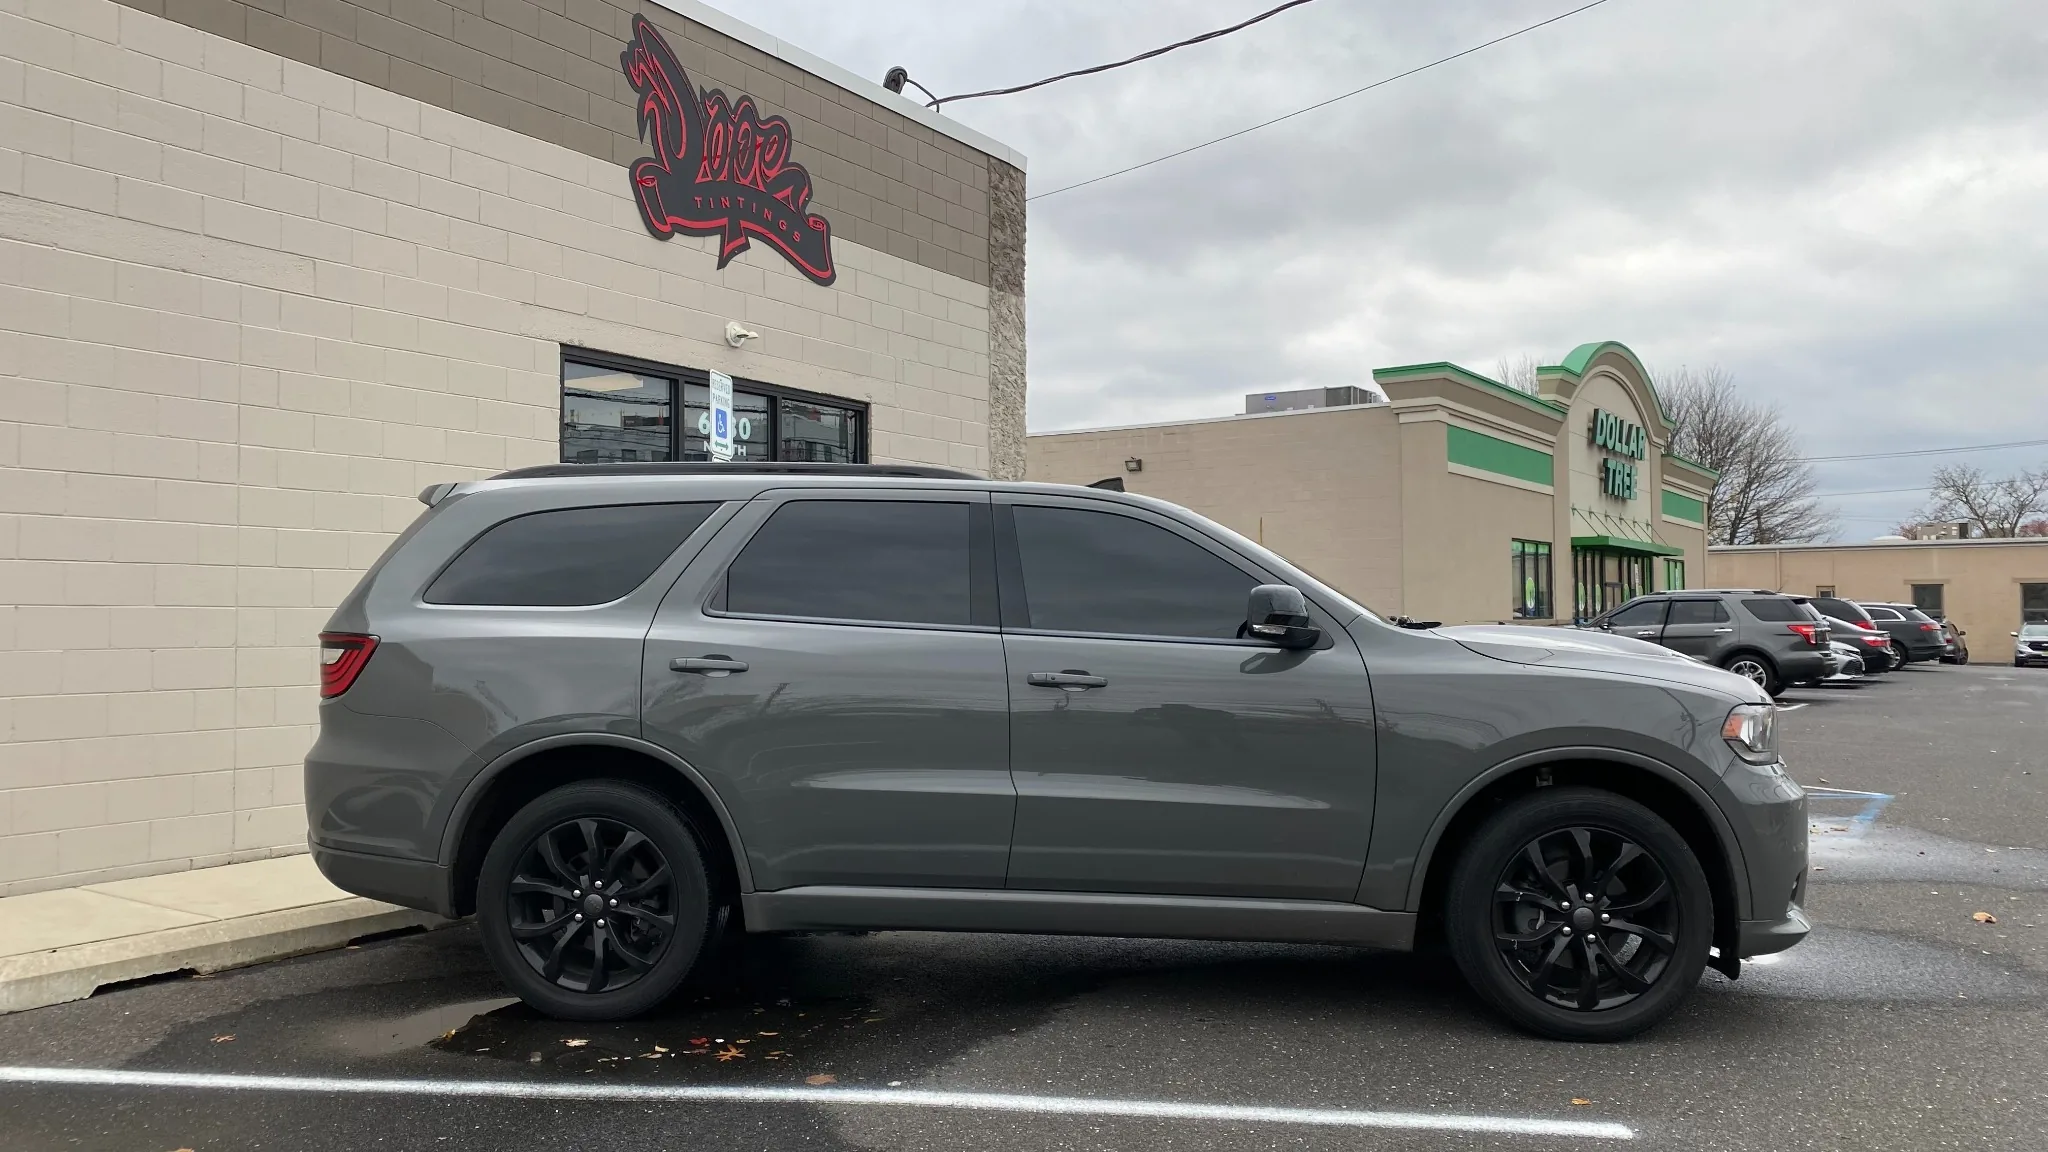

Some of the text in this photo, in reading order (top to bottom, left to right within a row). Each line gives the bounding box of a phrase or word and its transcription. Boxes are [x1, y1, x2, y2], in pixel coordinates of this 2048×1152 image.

[694, 196, 801, 243] TINTINGS
[712, 378, 731, 396] RESERVED
[712, 392, 731, 409] PARKING
[1593, 408, 1646, 461] DOLLAR
[1603, 457, 1638, 500] TREE
